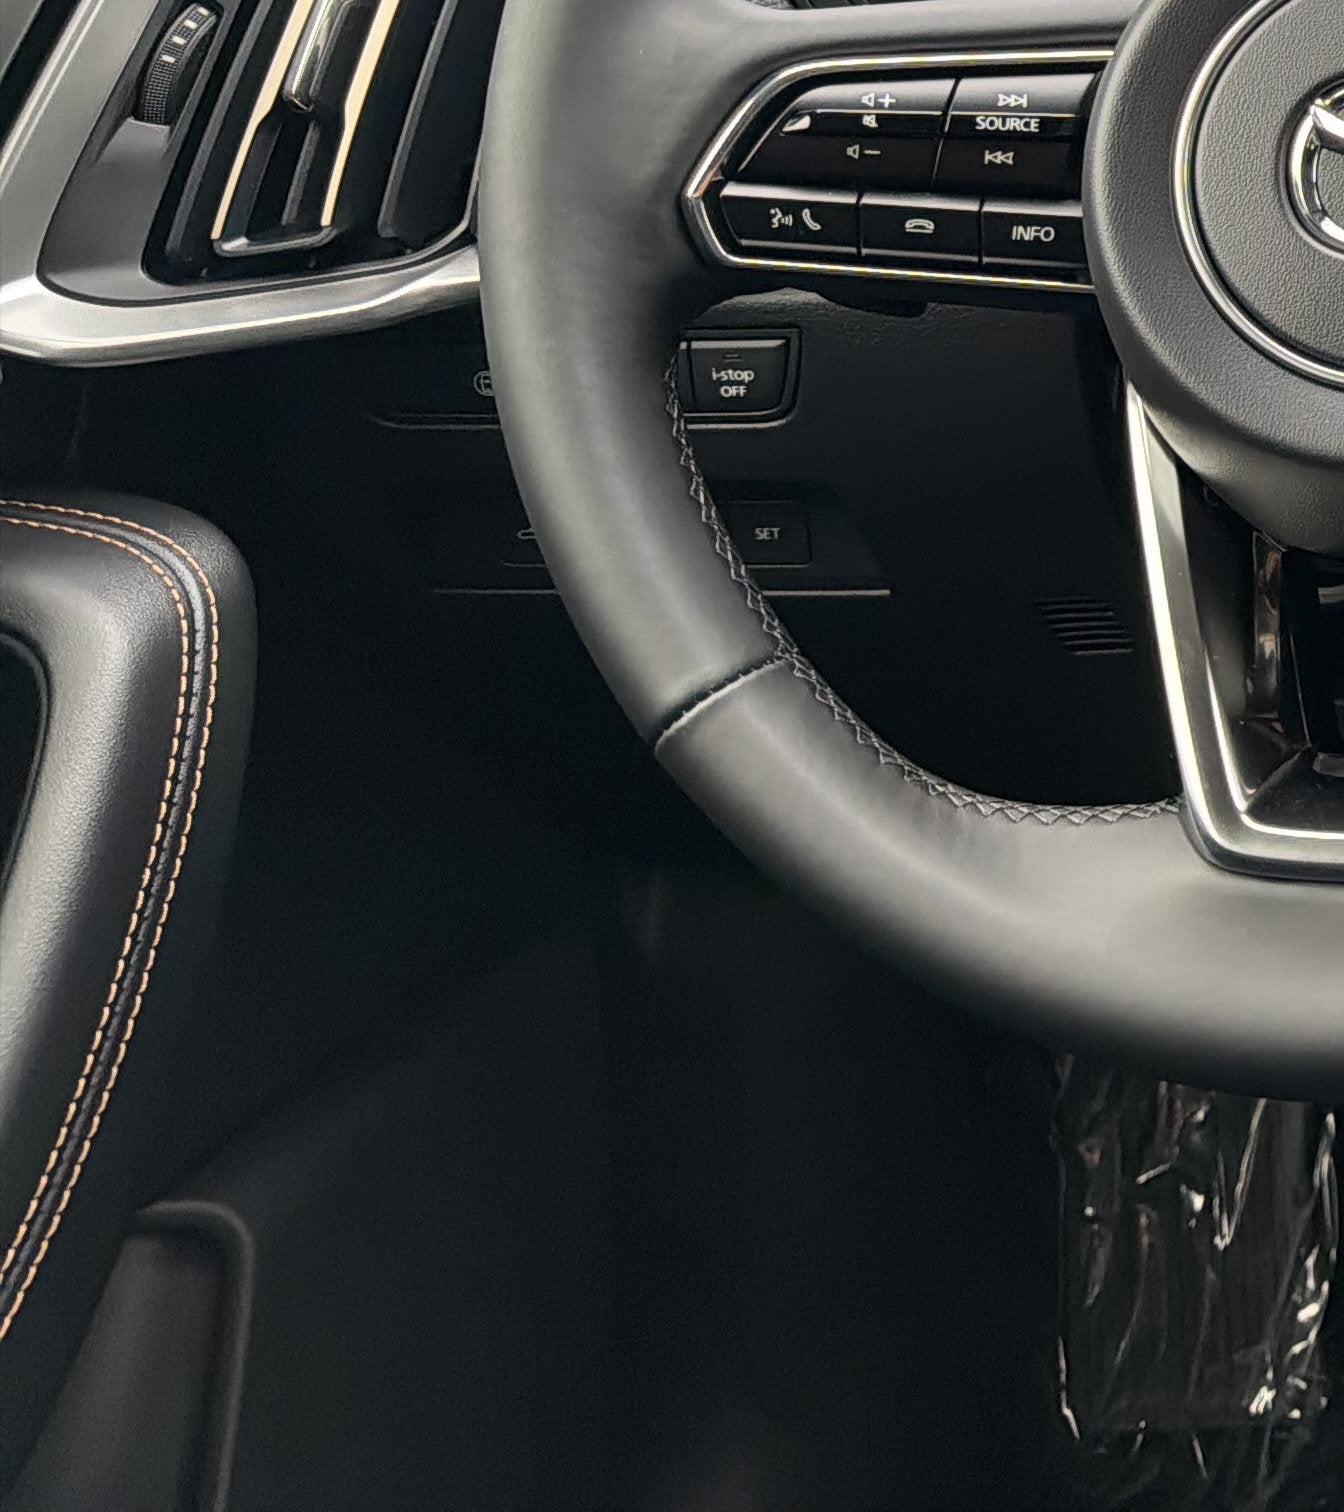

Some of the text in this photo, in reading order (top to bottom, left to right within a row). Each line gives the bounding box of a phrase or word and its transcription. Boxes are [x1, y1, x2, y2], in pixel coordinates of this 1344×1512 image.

[975, 115, 1040, 133] SOURCE
[1011, 224, 1055, 242] INFO
[711, 366, 756, 384] i-stop
[719, 384, 748, 398] OFF
[754, 525, 781, 541] SET
